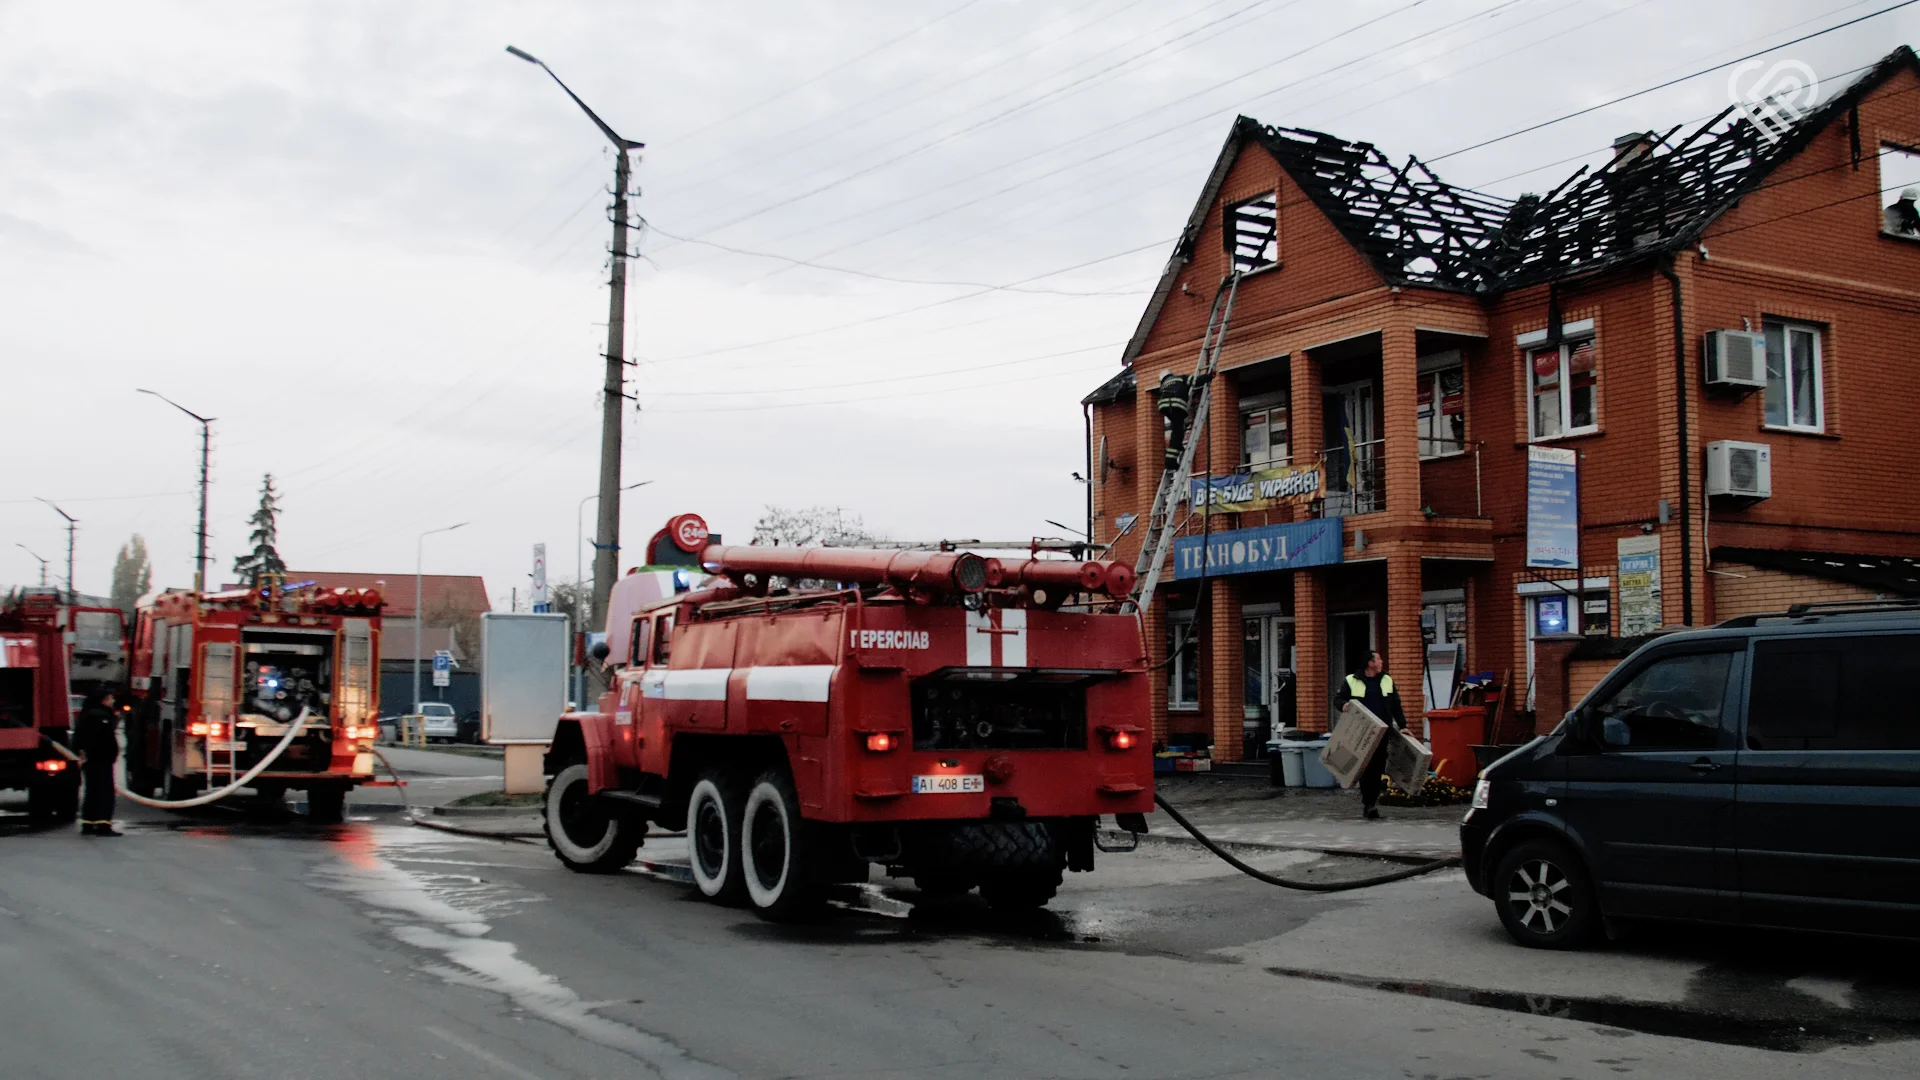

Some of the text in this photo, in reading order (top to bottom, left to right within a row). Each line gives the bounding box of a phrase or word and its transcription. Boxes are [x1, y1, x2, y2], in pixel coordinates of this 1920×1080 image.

[1195, 487, 1218, 506] ВЕ
[1223, 482, 1254, 503] БУДЕ
[1260, 470, 1319, 498] УКРАЇНА!
[1181, 536, 1288, 570] ТЕХНОБУД
[938, 778, 958, 791] 408
